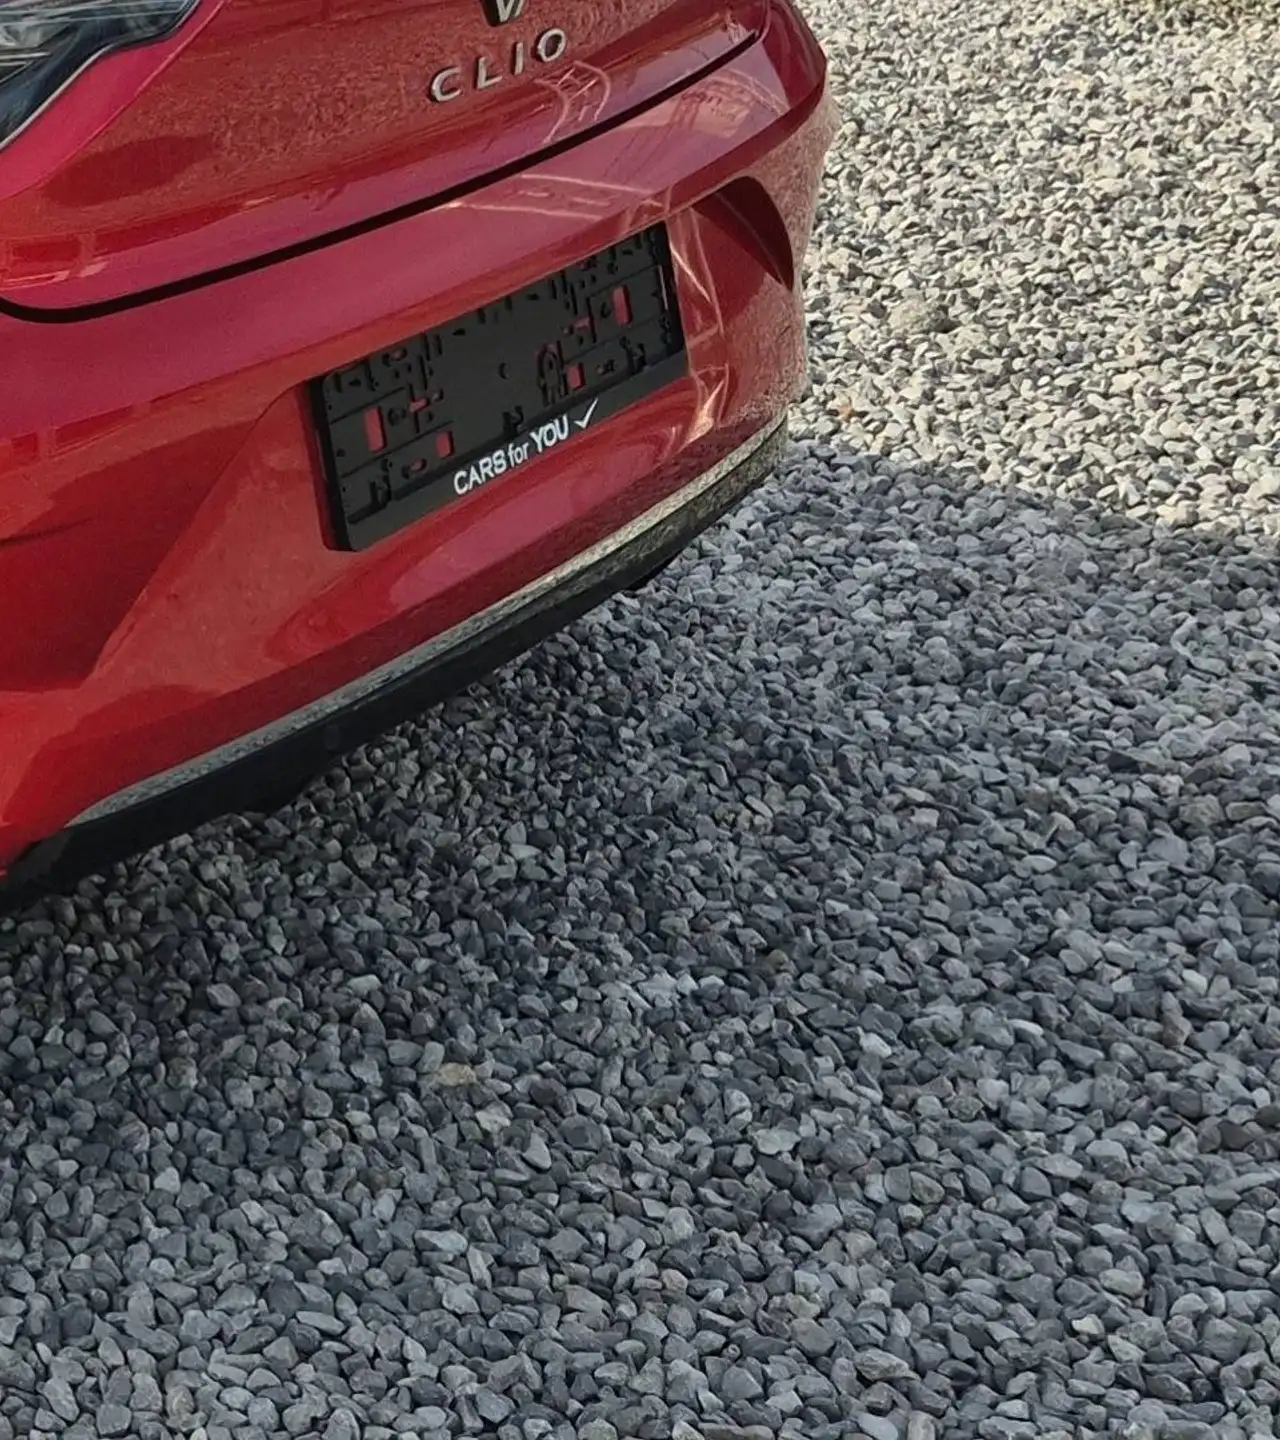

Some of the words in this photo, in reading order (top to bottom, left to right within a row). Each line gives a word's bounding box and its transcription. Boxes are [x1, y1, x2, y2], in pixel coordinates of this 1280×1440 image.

[429, 27, 567, 102] CLIO
[453, 448, 508, 495] CARS
[507, 441, 531, 467] for
[529, 414, 570, 453] YOU
